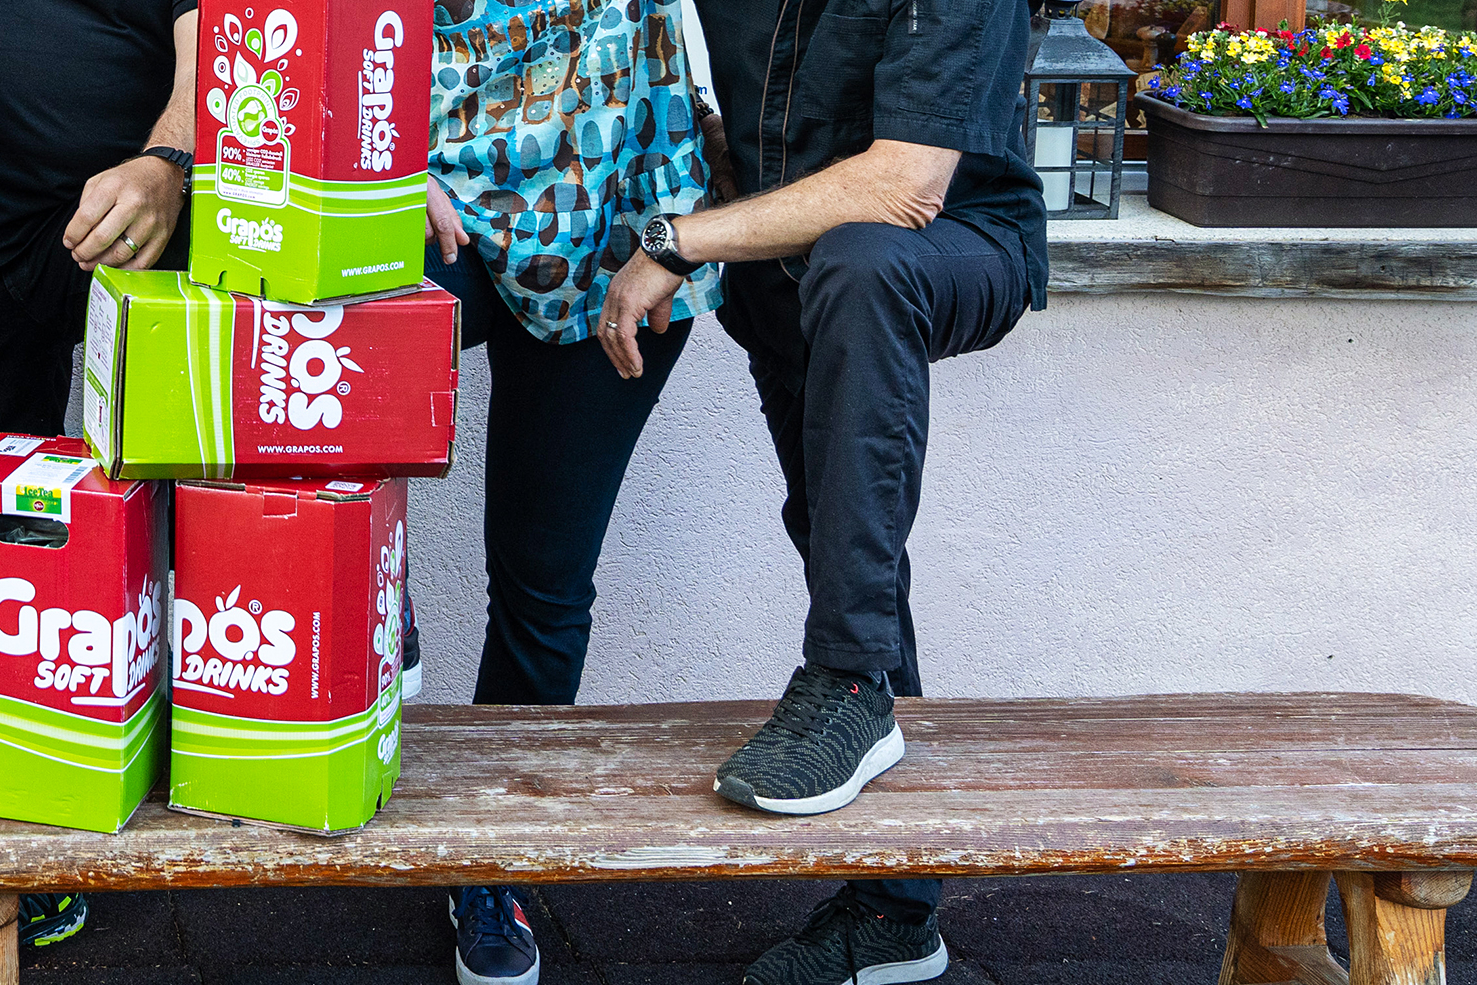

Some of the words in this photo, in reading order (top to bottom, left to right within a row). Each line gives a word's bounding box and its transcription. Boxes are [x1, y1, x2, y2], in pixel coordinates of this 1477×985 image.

[363, 48, 374, 93] SOFT
[223, 146, 242, 161] 90%
[360, 106, 373, 170] DRINKS
[222, 168, 242, 182] 40%
[229, 234, 248, 245] SOFT
[253, 238, 281, 252] DRINKS
[341, 261, 404, 277] WWW.GRAPOS.COM
[259, 312, 290, 425] DRINKS
[34, 660, 110, 695] SOFT
[128, 636, 160, 692] DRINKS
[182, 654, 290, 696] DRINKS
[311, 611, 321, 699] WWW.GRAPOS.COM
